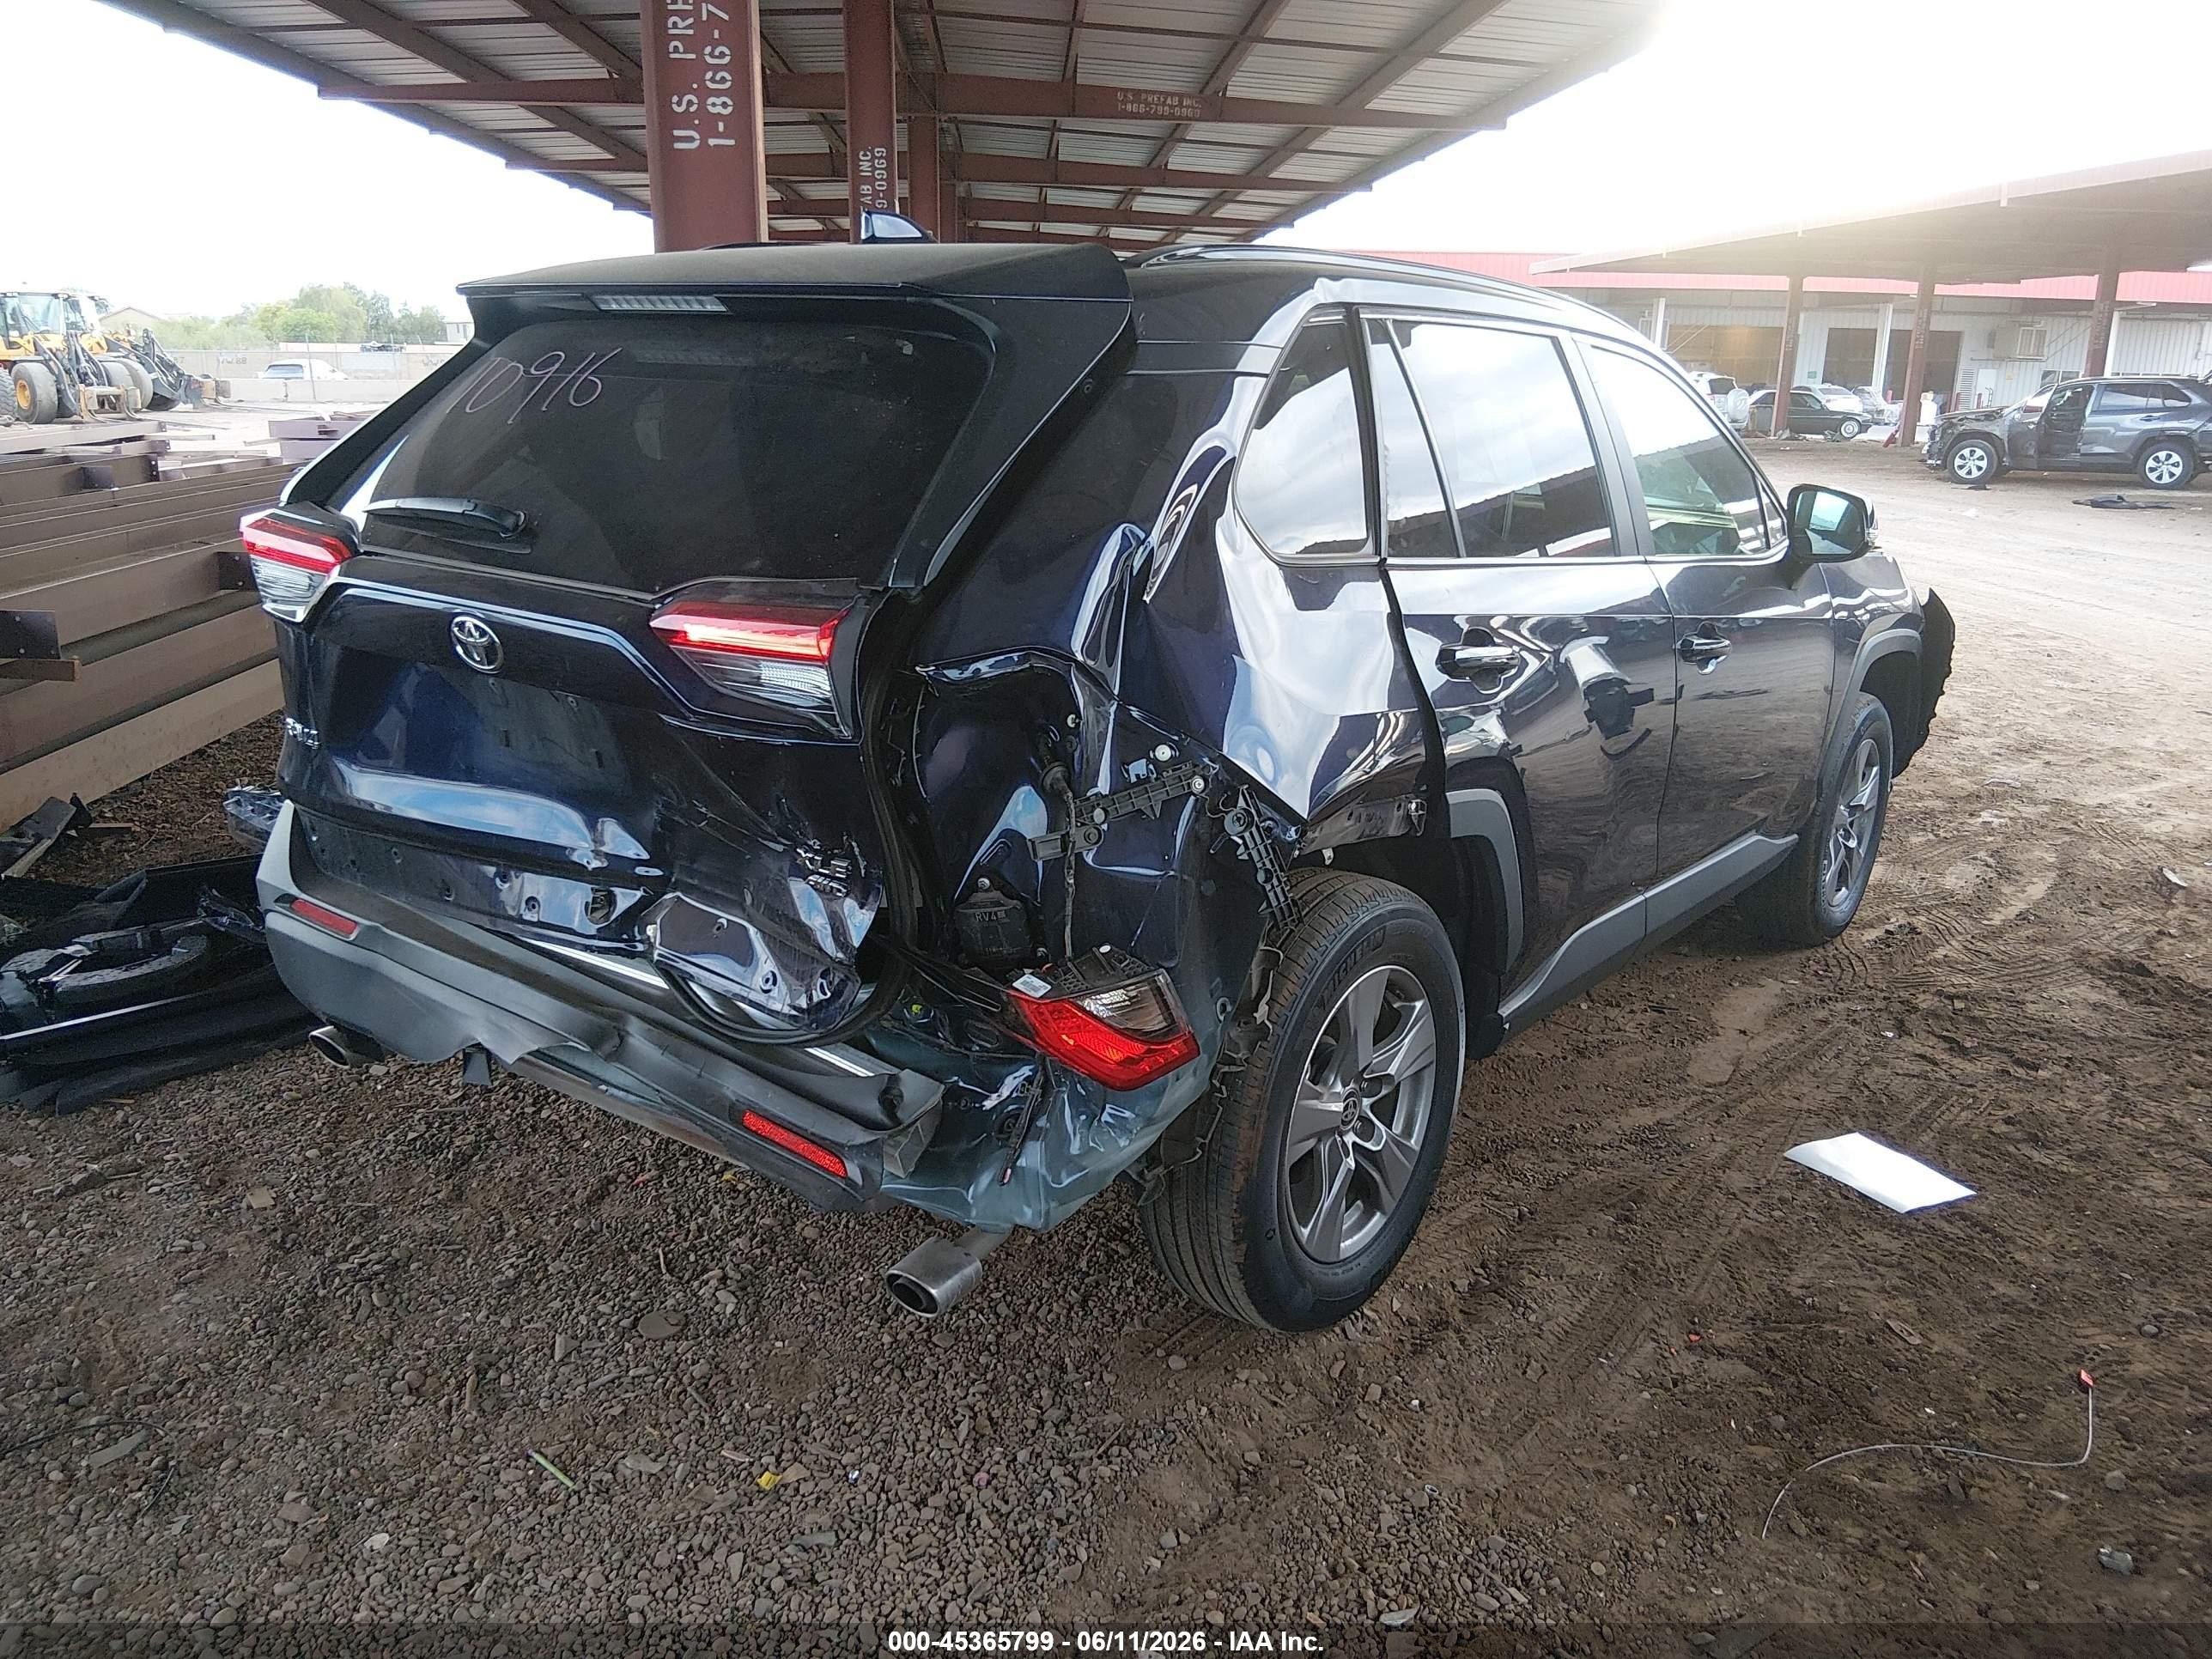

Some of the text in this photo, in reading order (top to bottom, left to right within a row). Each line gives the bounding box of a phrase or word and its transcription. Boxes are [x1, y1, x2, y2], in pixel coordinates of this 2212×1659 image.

[672, 83, 701, 149] U.S.
[1141, 93, 1179, 106] PREFAB
[859, 146, 872, 175] INC.
[446, 347, 623, 425] 10916
